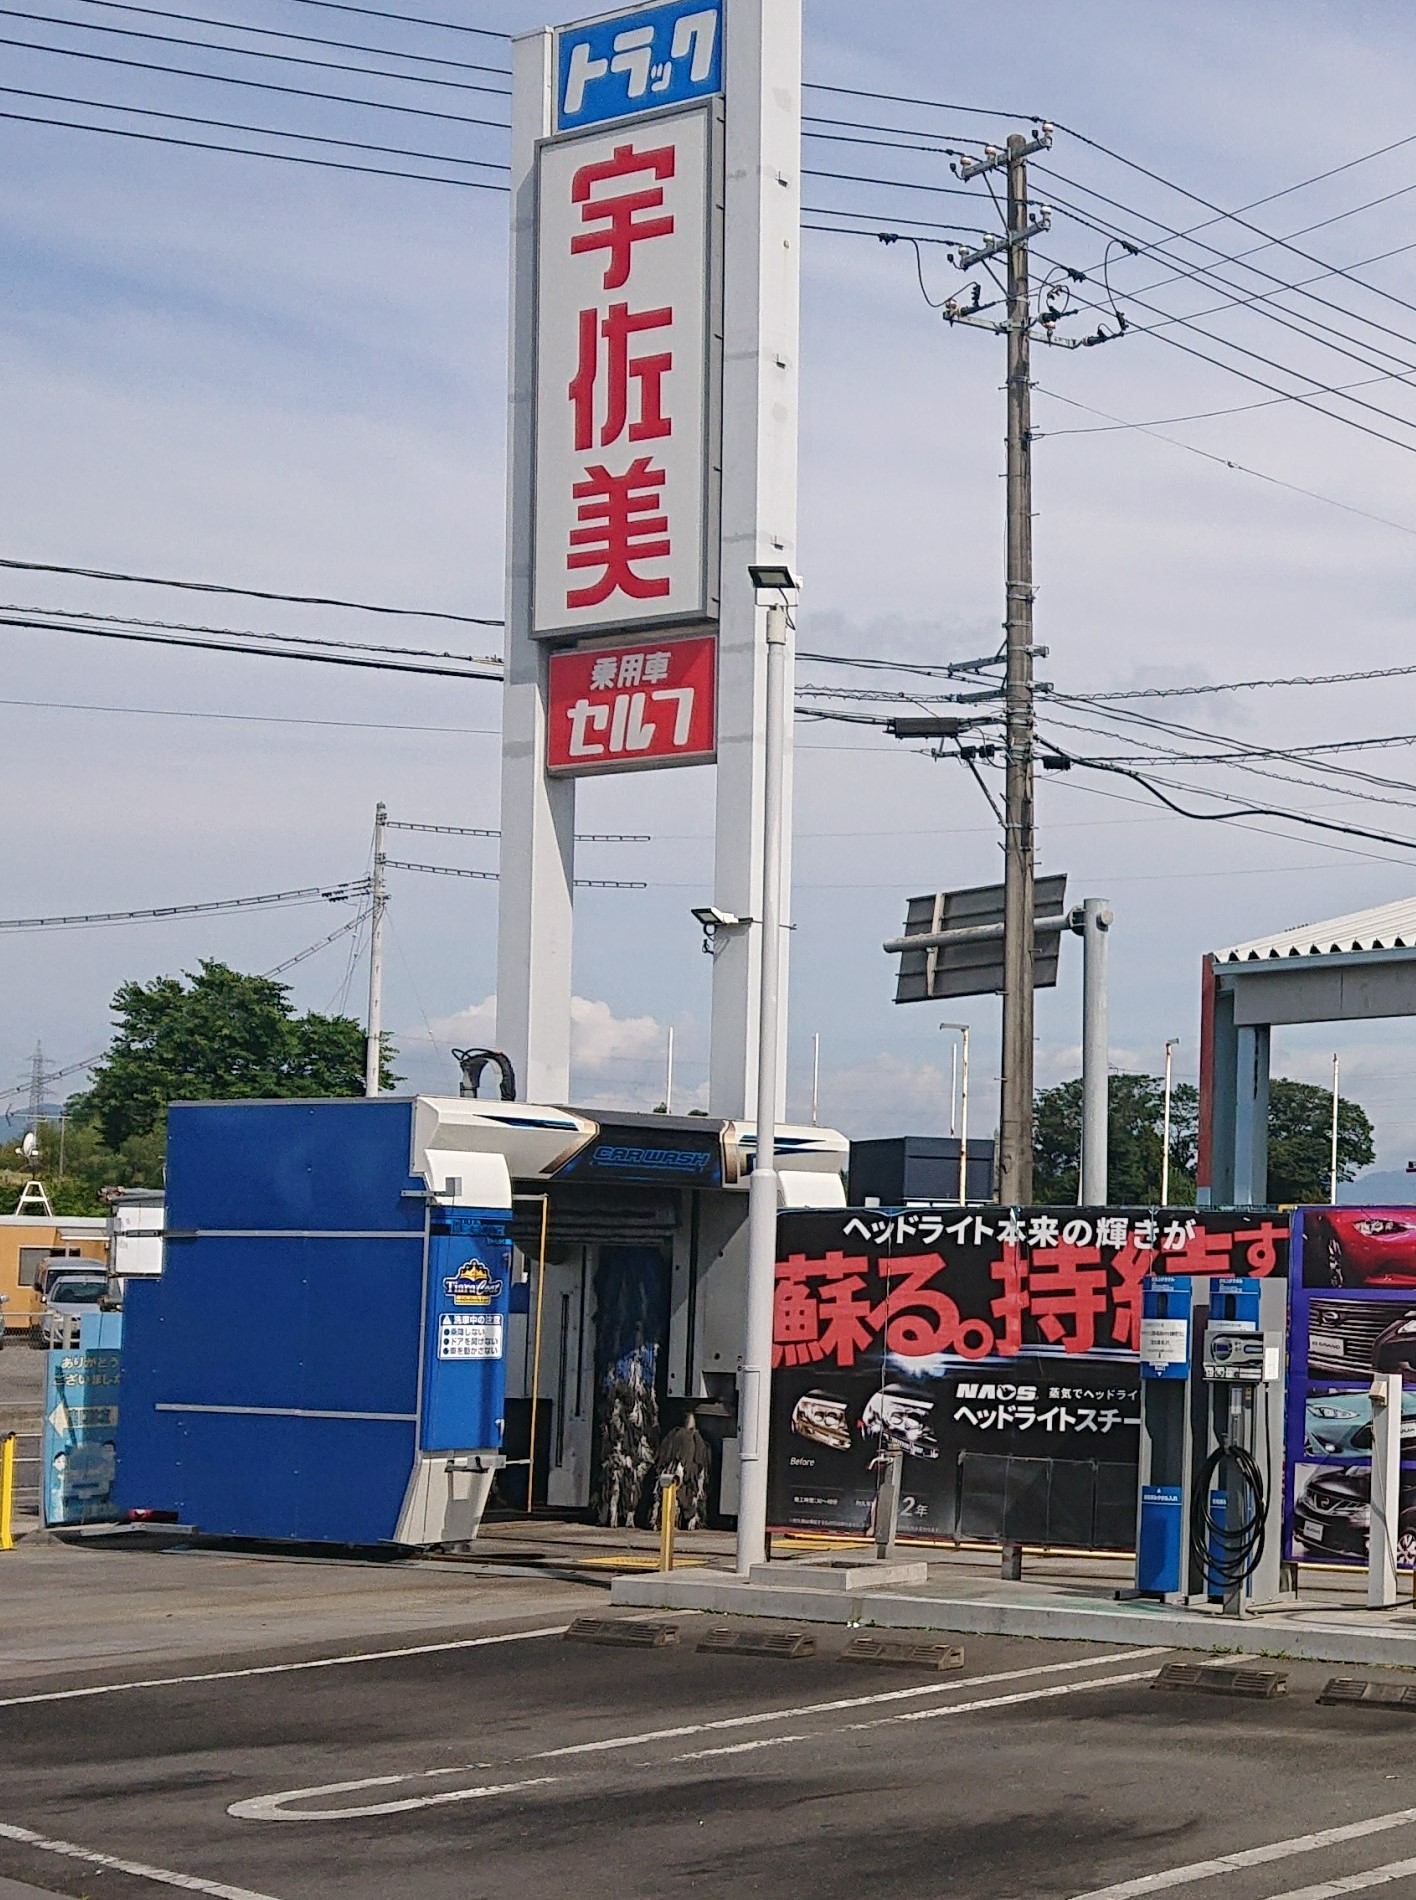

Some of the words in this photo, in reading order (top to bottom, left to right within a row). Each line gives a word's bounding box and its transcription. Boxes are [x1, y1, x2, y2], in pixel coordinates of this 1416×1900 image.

[564, 9, 717, 115] トラック
[566, 143, 676, 609] 宇佐美
[590, 650, 668, 690] 乗用車
[567, 686, 693, 757] セルフ
[843, 1216, 1198, 1251] ヘッドライト本来の輝きが
[445, 1281, 476, 1294] Tiara
[61, 1356, 120, 1369] ありがとう
[953, 1404, 1142, 1433] ヘッドライトスチー
[790, 1456, 816, 1467] Before
[900, 1496, 929, 1518] 2年
